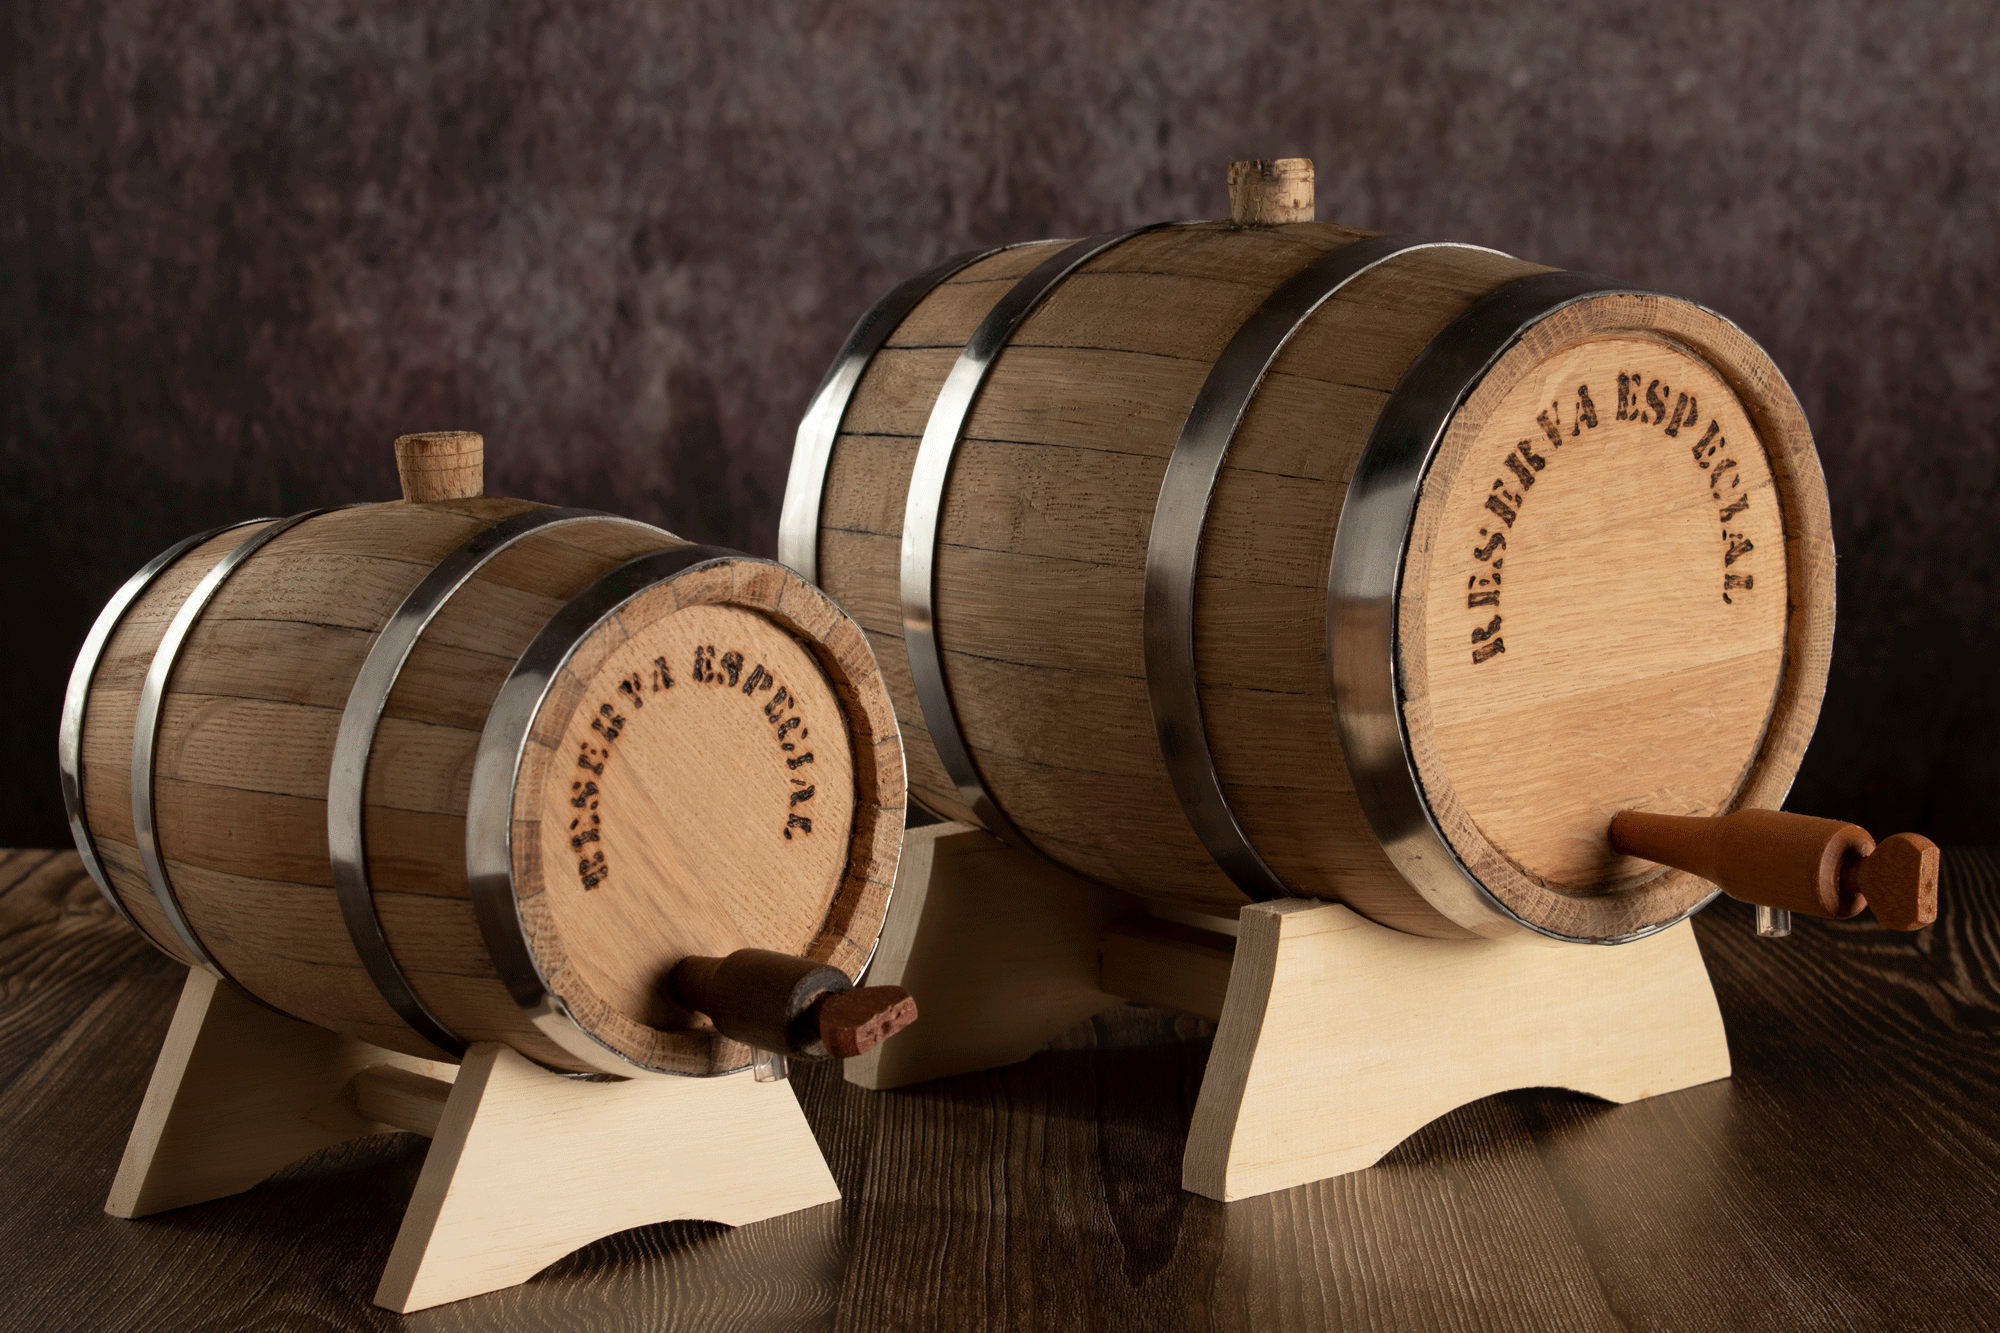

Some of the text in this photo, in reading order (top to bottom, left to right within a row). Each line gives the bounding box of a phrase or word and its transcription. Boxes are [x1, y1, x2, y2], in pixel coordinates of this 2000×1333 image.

[1468, 372, 1754, 664] RESERVA ESPECIAL
[570, 645, 815, 891] RESERVA ESPECIAL
